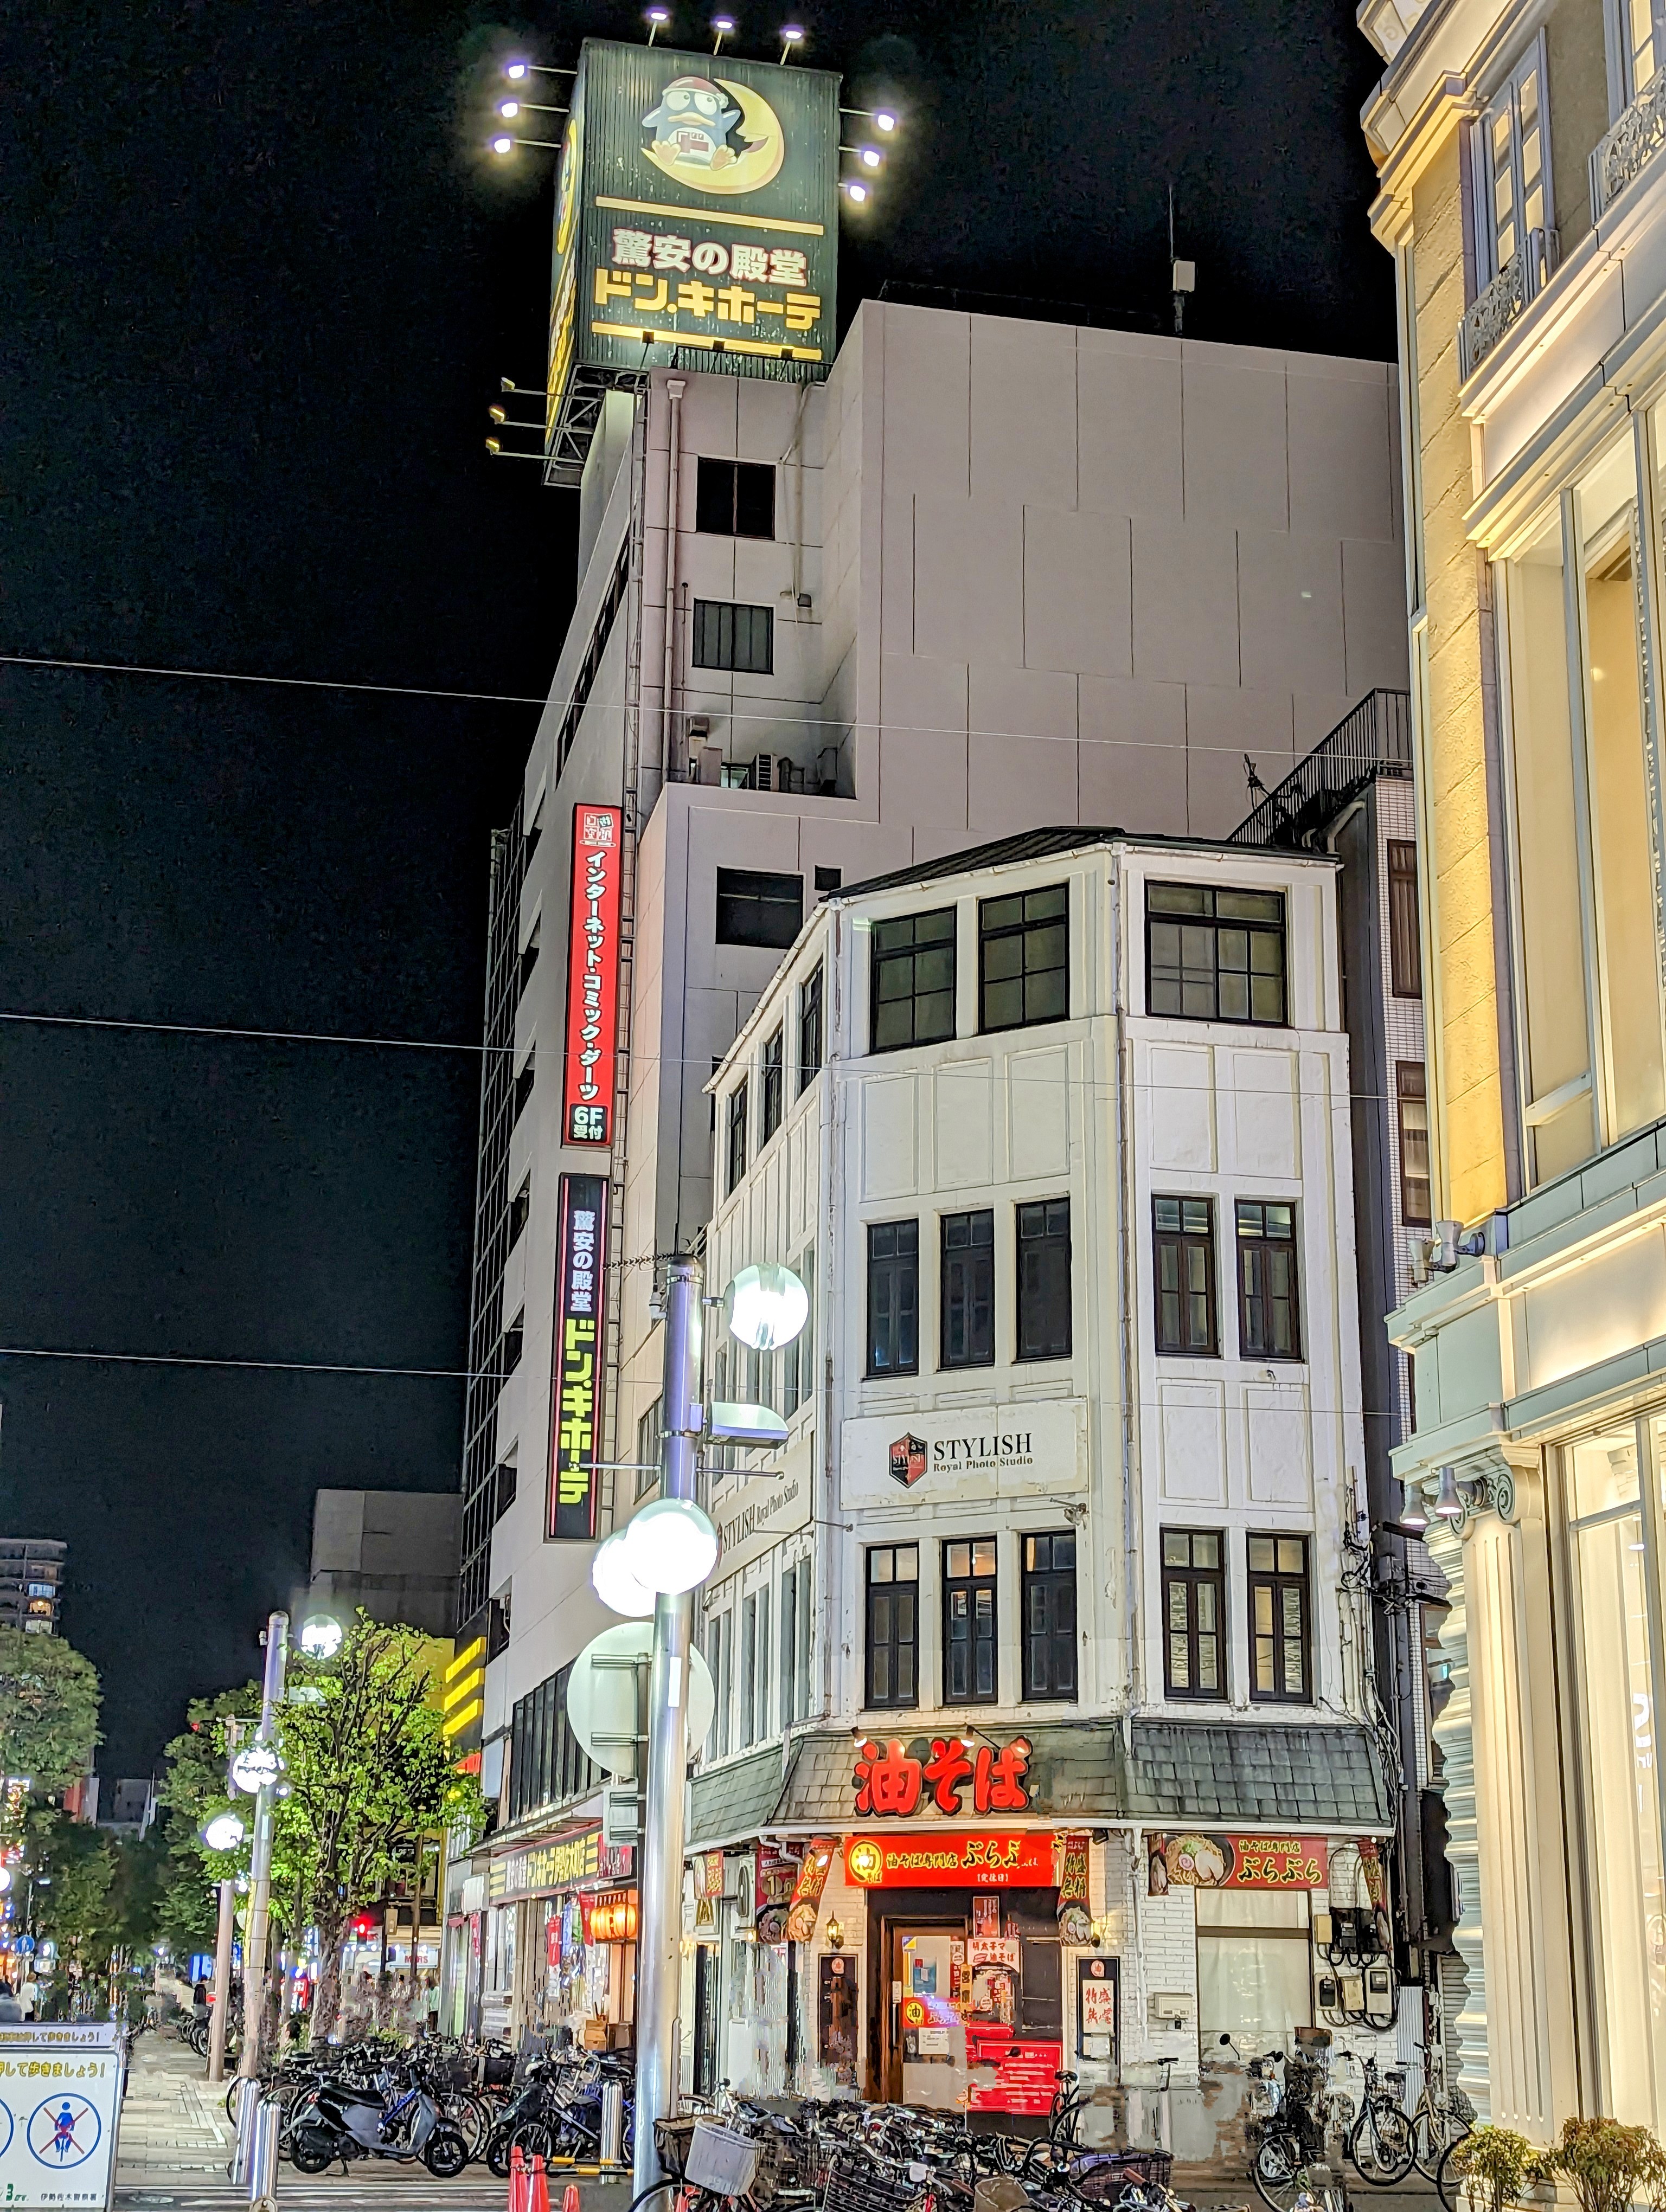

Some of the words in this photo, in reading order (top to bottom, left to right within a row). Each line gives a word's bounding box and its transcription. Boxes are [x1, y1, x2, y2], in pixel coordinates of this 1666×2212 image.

[612, 228, 807, 286] 驚安の殿堂
[575, 1106, 603, 1125] 6F
[573, 1124, 603, 1140] 受付
[570, 1210, 595, 1313] 驚安の殿堂
[933, 1432, 1033, 1461] STYLISH
[933, 1461, 962, 1473] Royal
[966, 1459, 996, 1470] Photo
[999, 1456, 1033, 1467] Studio
[723, 1503, 755, 1554] STYLISH
[854, 1737, 1030, 1814] 油そば
[1237, 1856, 1322, 1885] ぶらぶら
